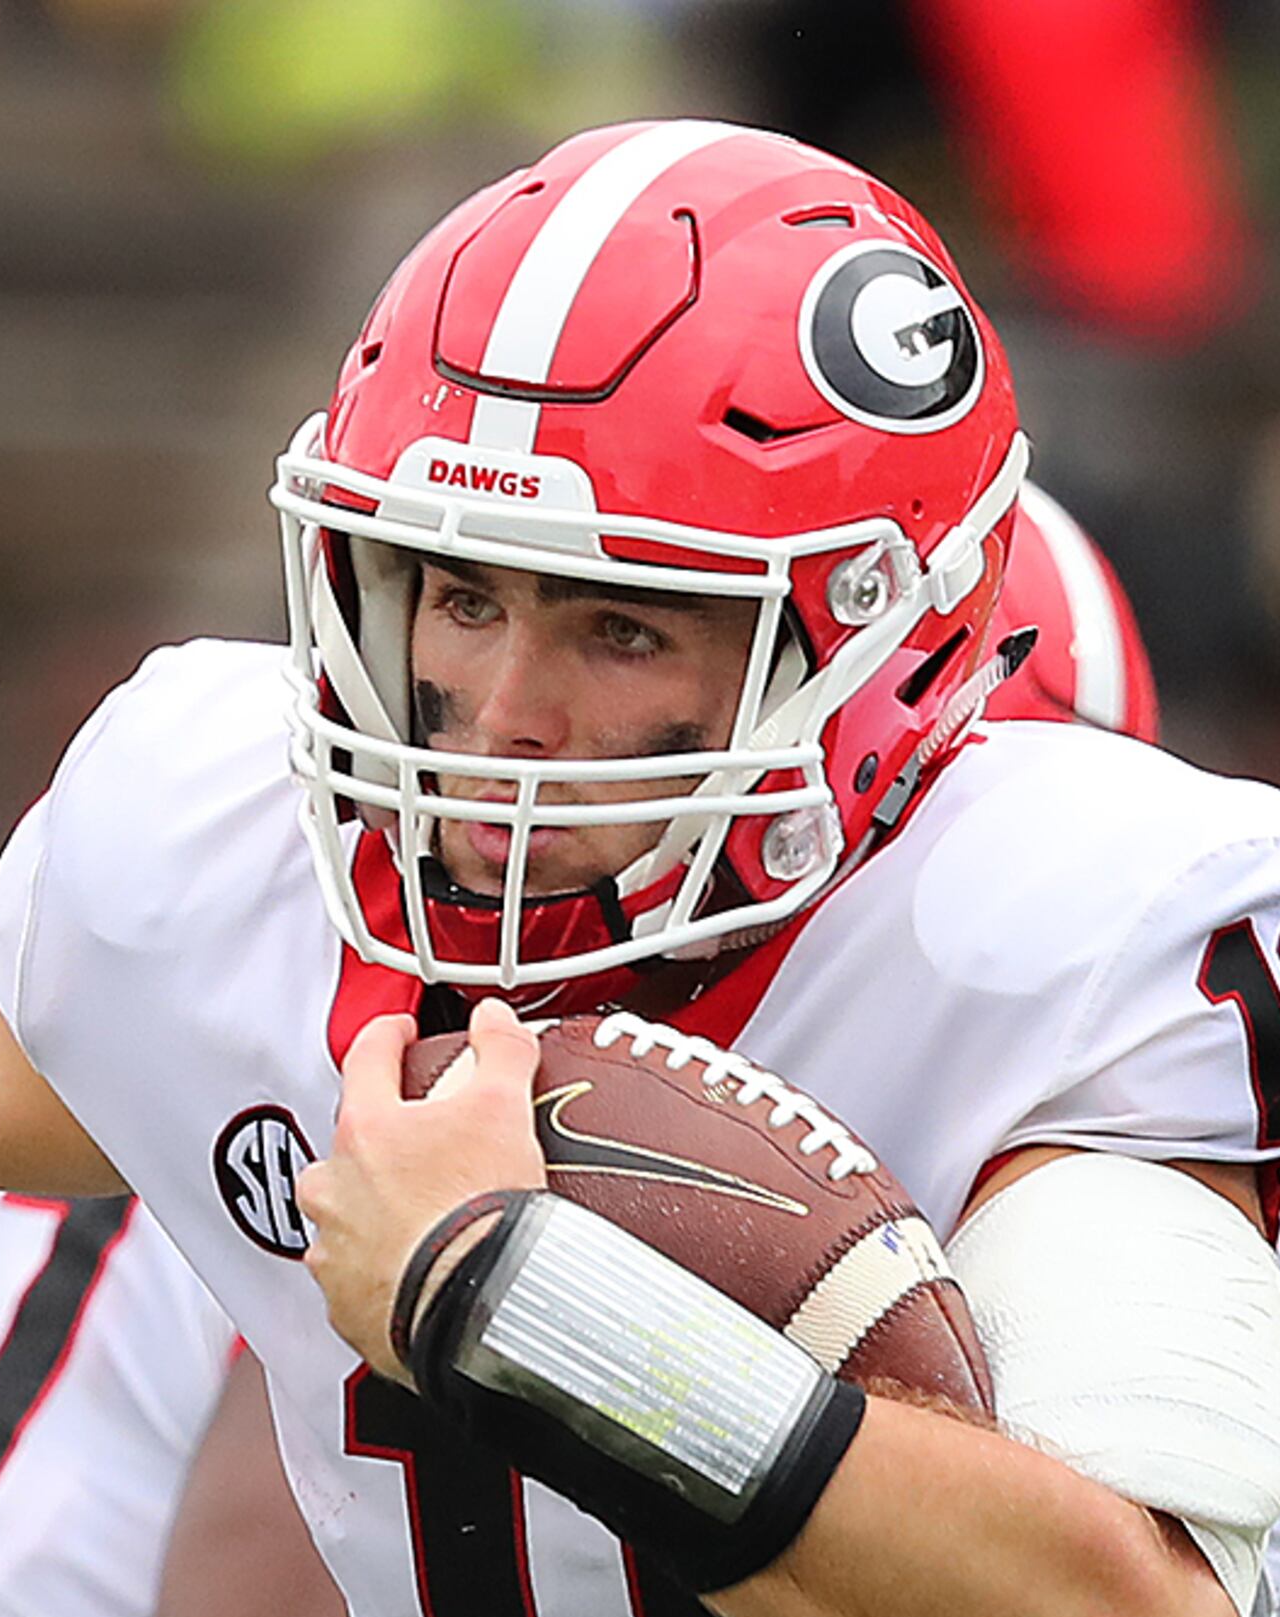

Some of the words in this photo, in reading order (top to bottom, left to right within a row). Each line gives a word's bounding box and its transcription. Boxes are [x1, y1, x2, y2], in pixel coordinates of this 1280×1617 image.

[810, 247, 979, 422] G
[427, 457, 541, 499] DAWGS
[225, 1118, 318, 1248] SE
